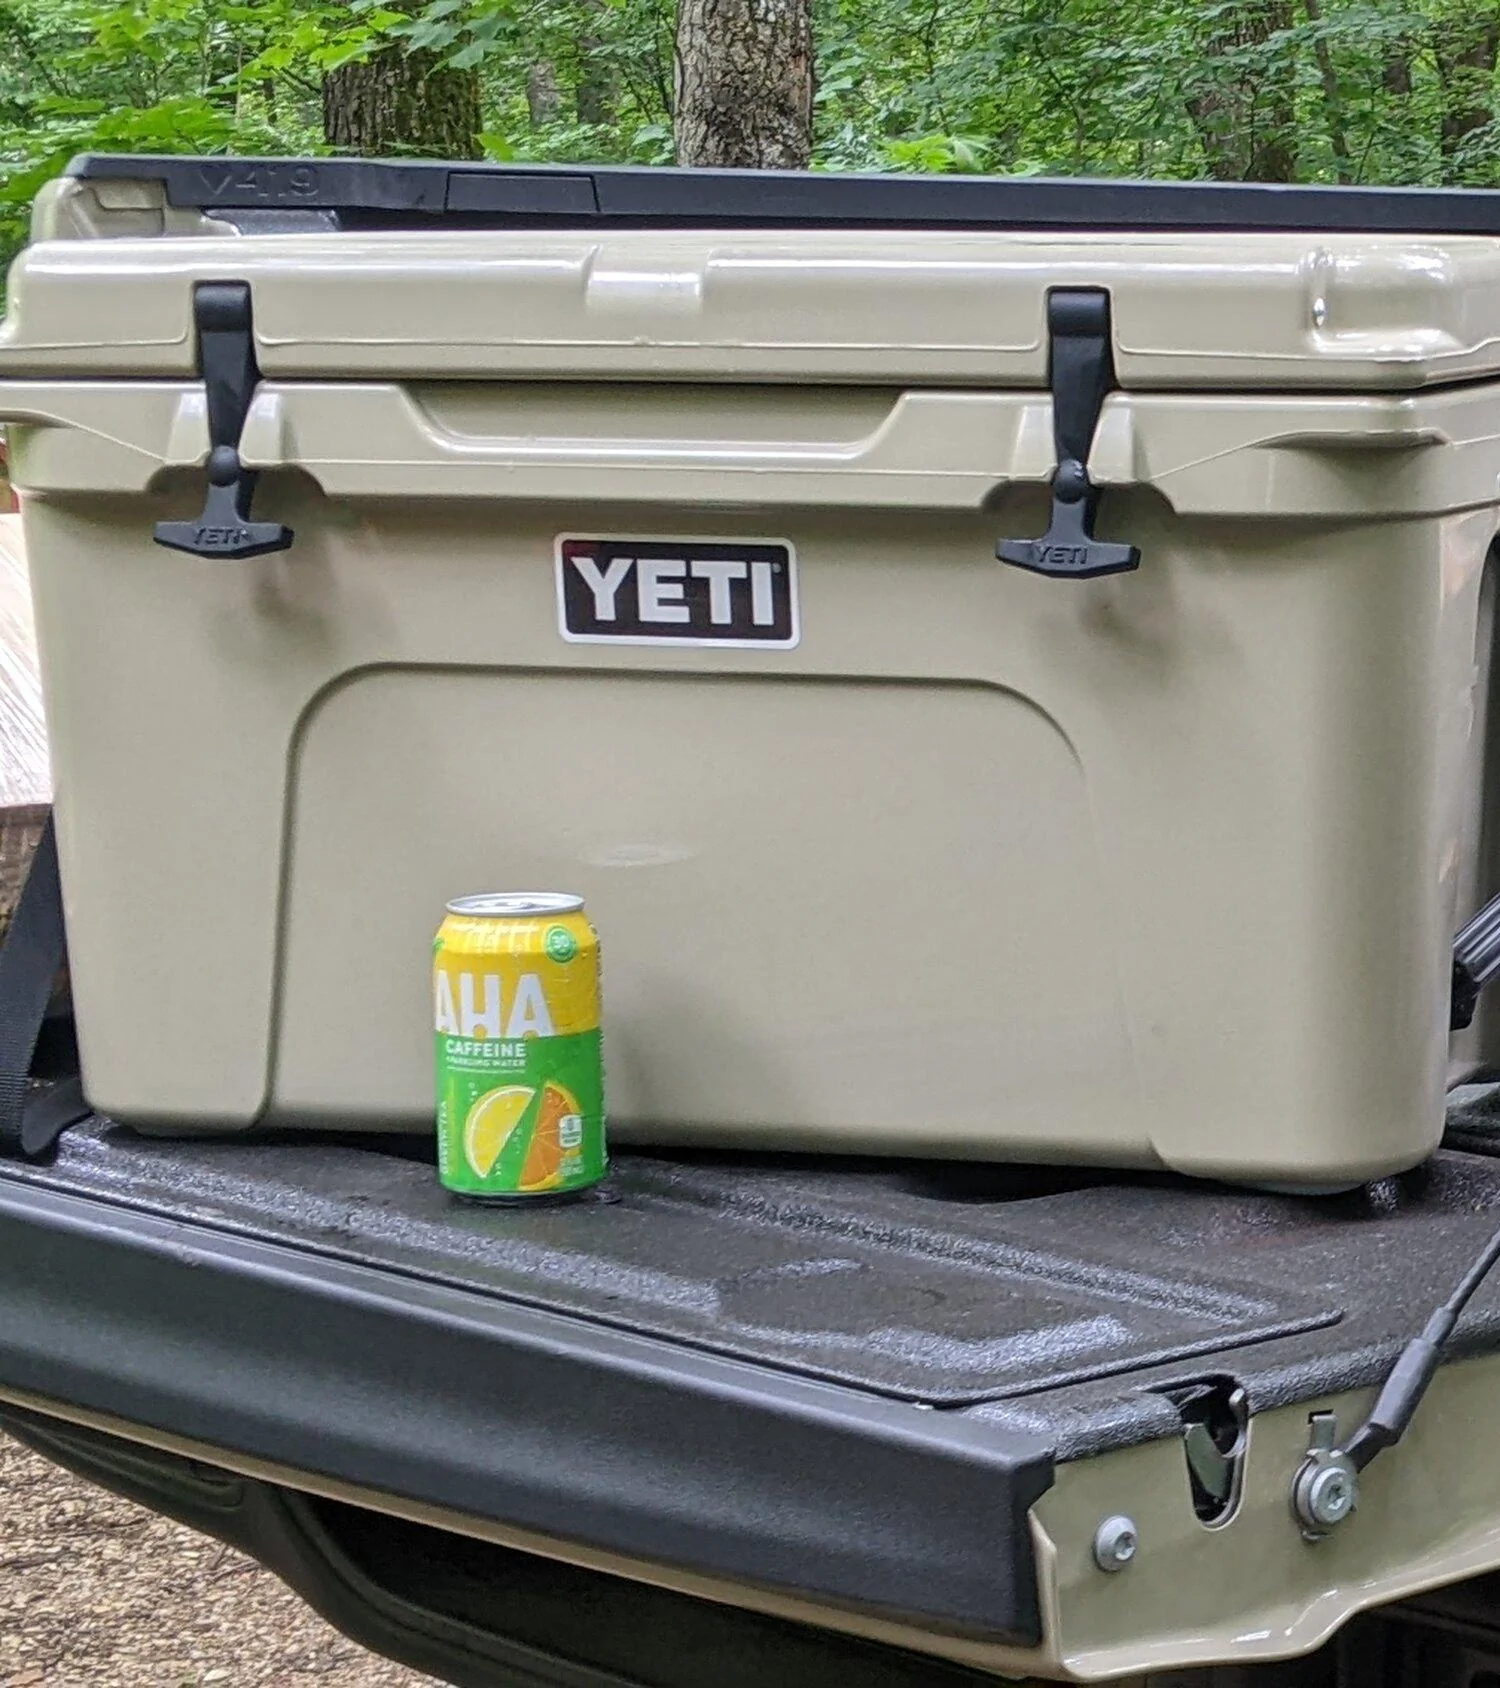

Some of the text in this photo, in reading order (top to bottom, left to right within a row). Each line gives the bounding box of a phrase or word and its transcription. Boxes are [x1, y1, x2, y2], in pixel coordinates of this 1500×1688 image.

[1036, 546, 1088, 565] YETI
[571, 556, 775, 626] YETI
[436, 970, 557, 1037] AHA
[446, 1039, 527, 1057] CAFFEINE
